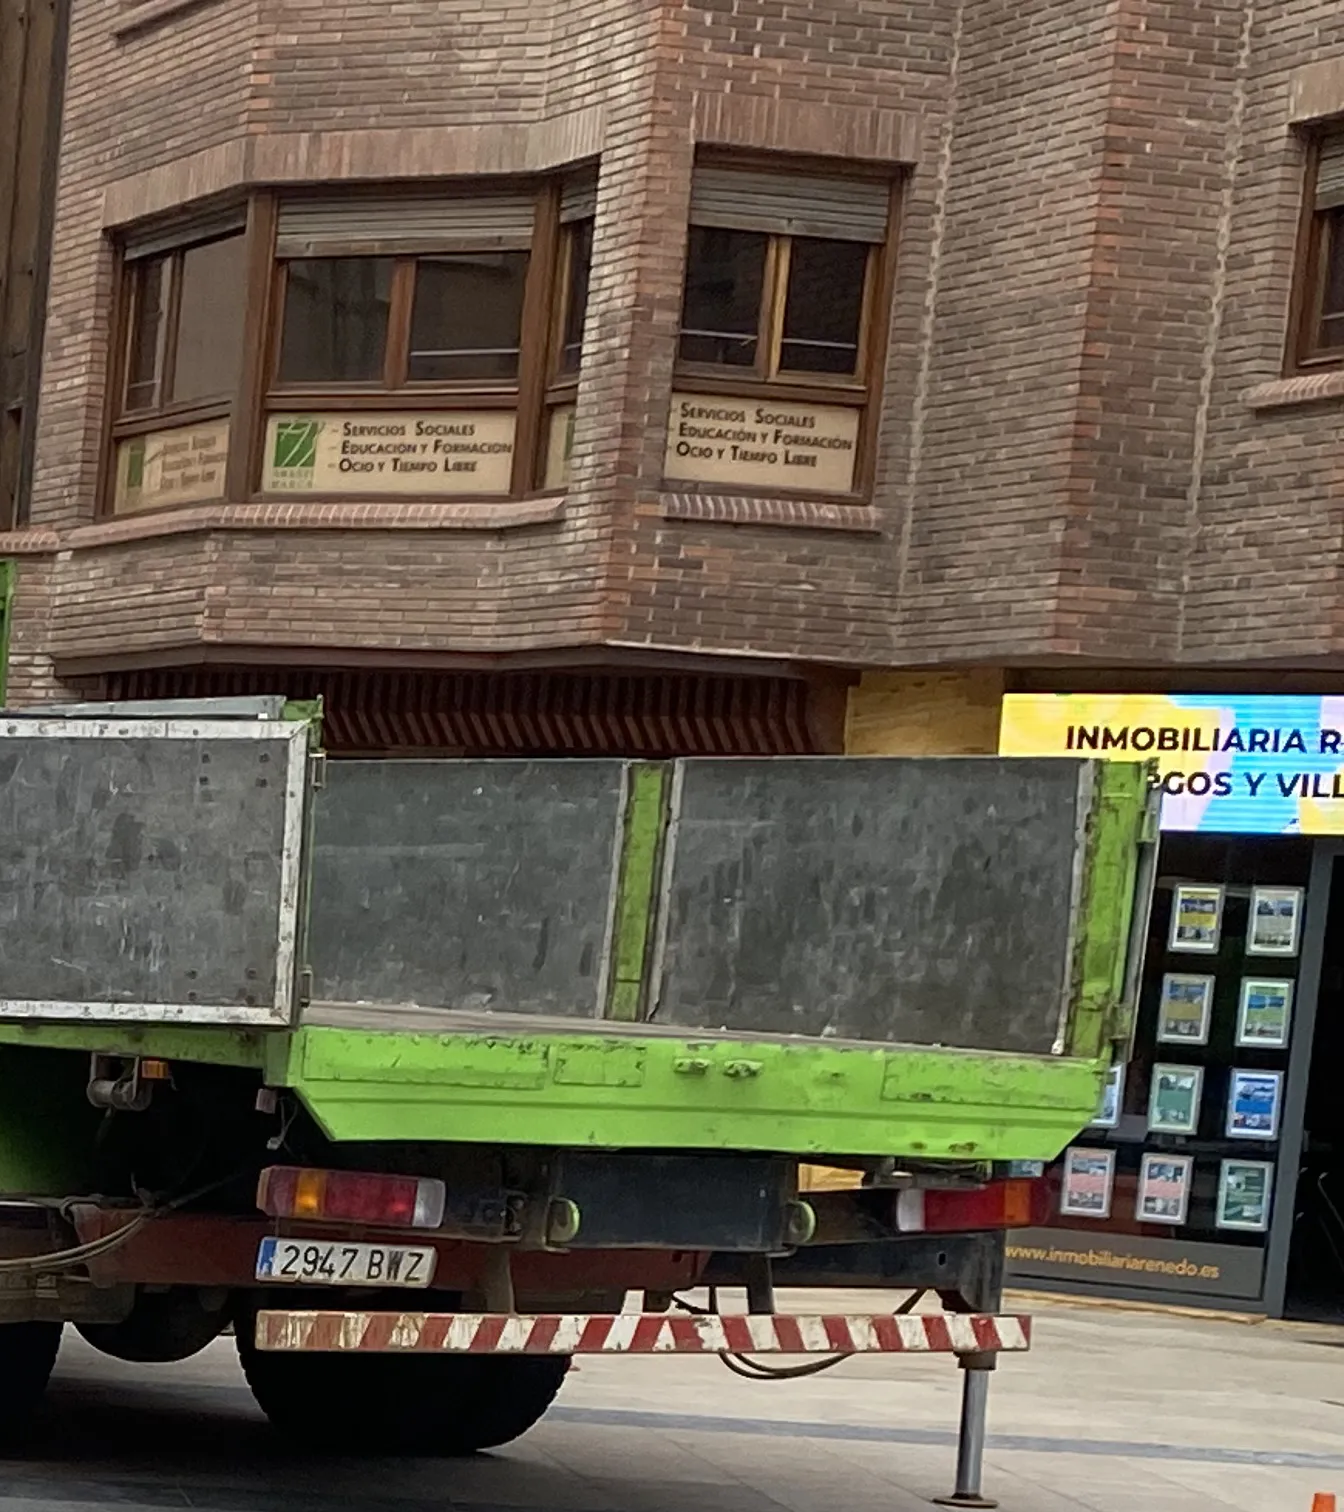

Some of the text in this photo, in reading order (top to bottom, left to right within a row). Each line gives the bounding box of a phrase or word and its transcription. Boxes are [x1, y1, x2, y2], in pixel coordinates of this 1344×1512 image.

[1066, 725, 1344, 755] INMOBILIARIA R
[1243, 772, 1267, 797] Y
[280, 1244, 425, 1282] 2947 BWZ
